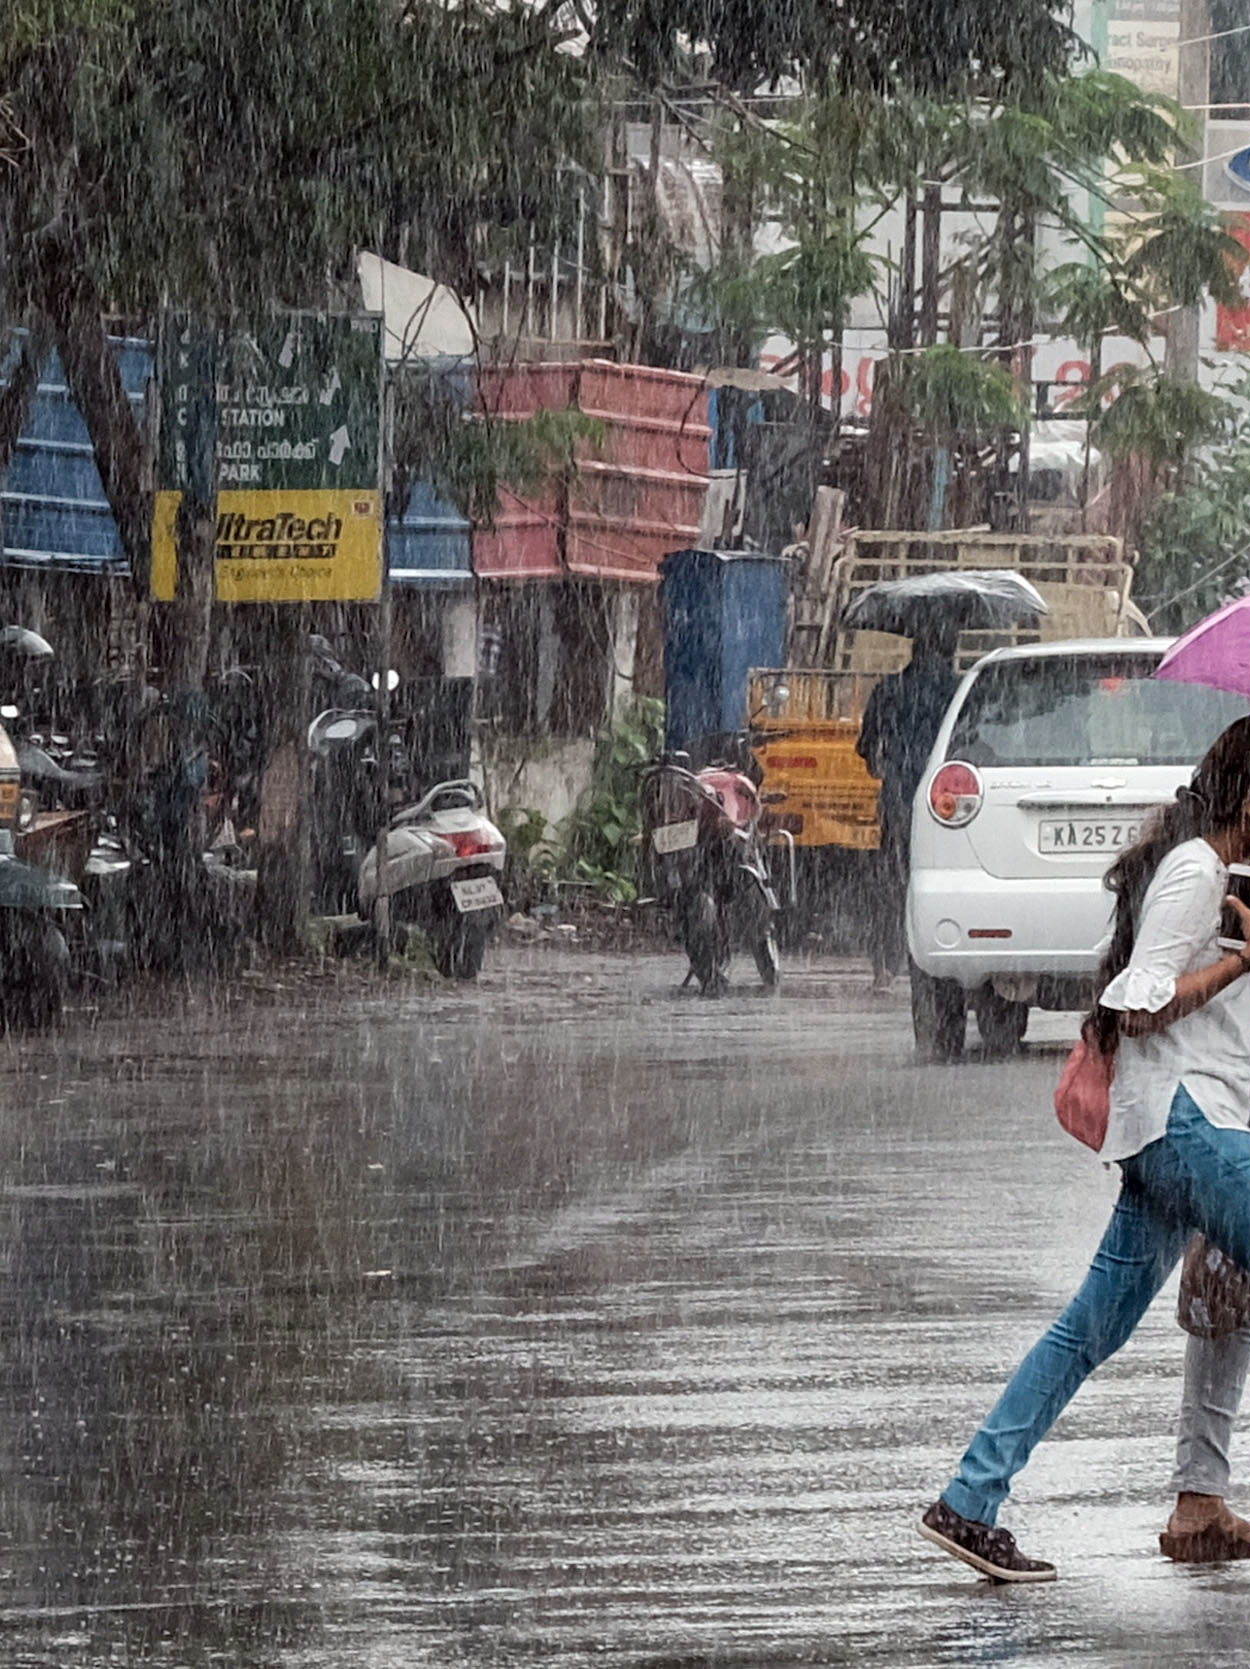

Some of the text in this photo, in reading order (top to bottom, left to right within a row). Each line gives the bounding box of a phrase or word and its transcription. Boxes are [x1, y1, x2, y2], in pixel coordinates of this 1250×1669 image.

[221, 408, 285, 427] STATION
[219, 463, 261, 482] PARK
[1053, 823, 1077, 846] KA
[1082, 825, 1106, 846] 25
